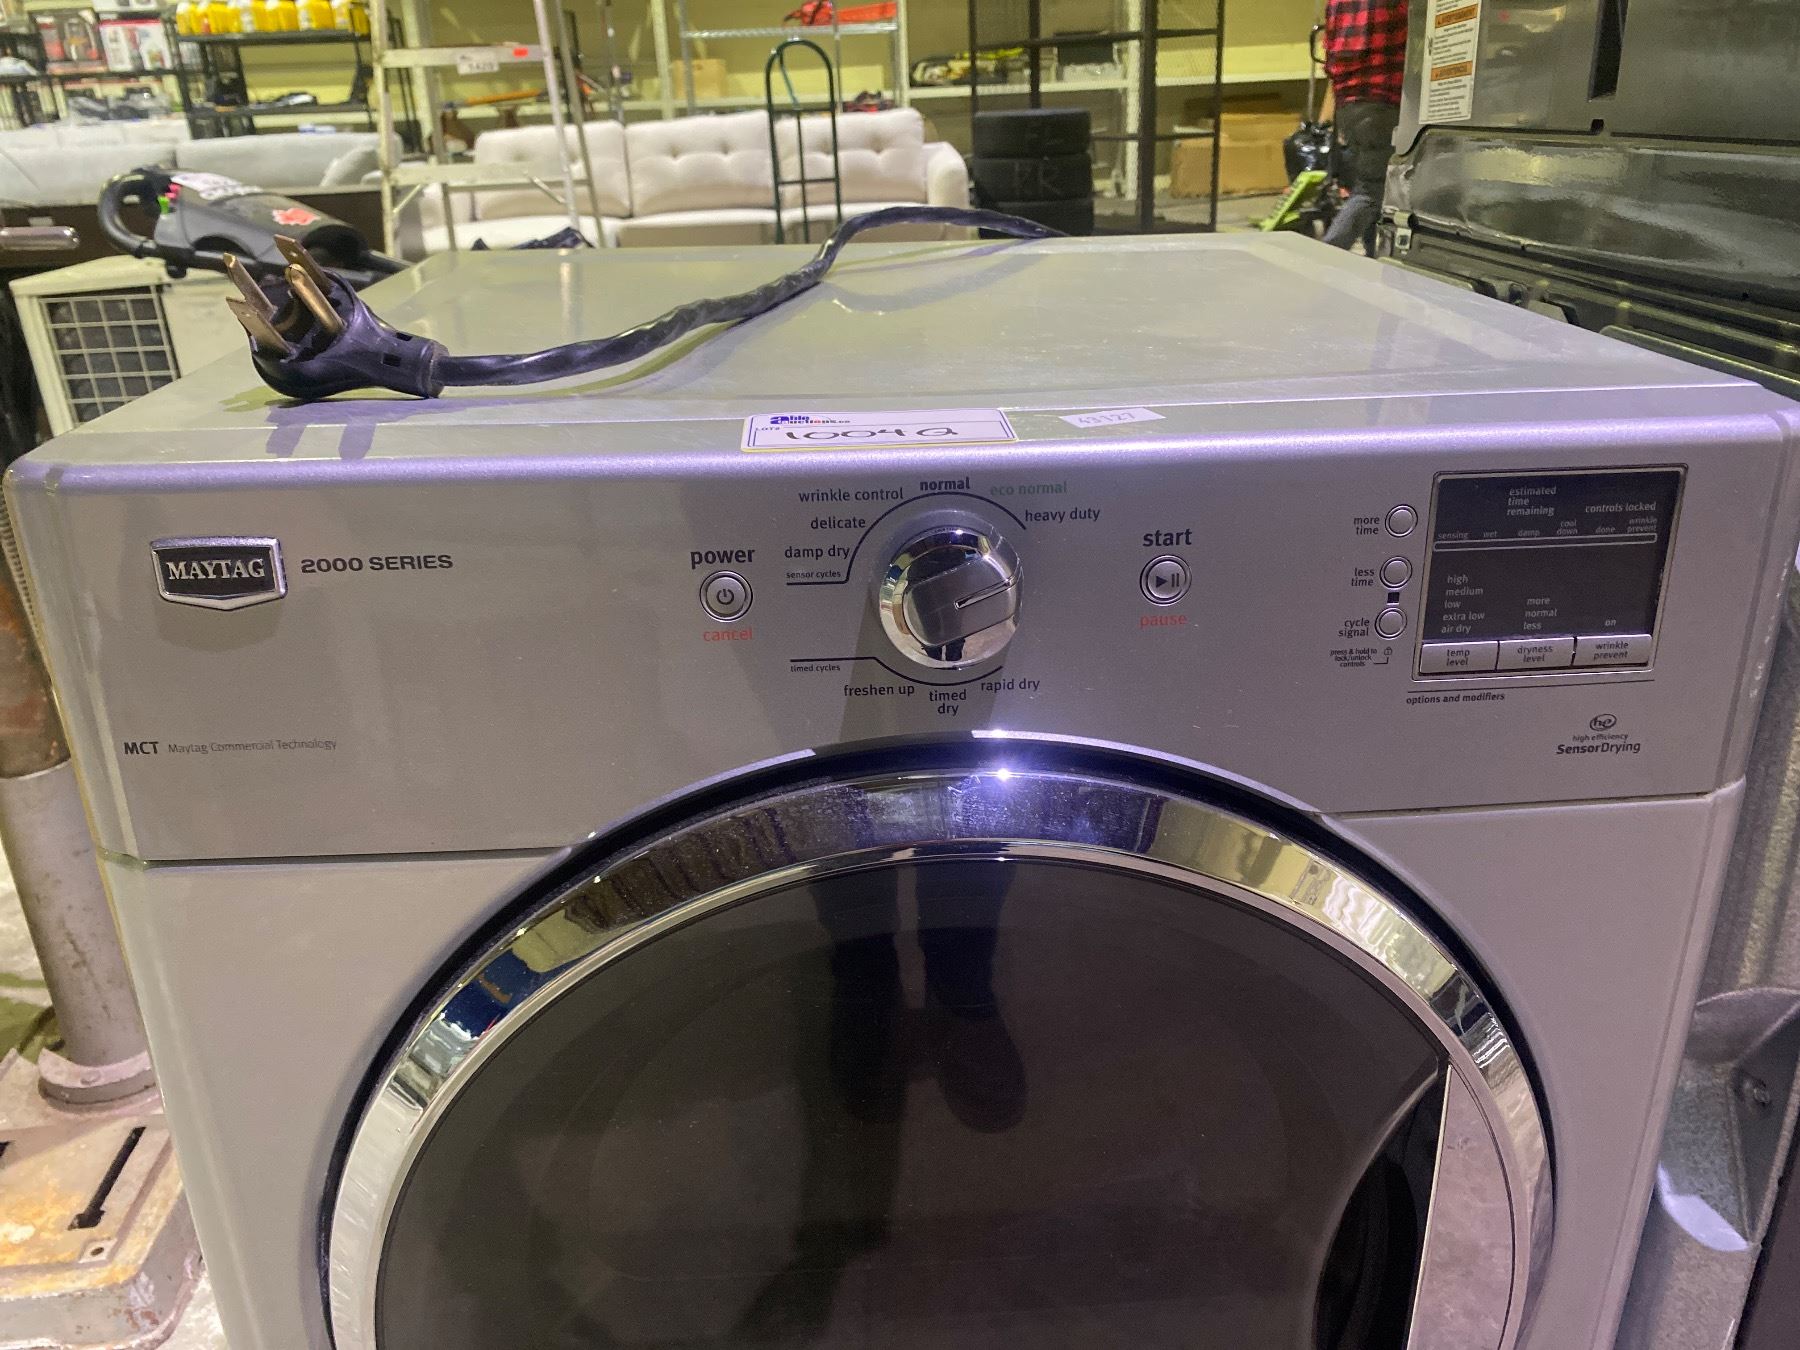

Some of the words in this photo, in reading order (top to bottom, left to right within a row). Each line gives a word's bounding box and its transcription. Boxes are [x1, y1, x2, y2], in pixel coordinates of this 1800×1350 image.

[920, 476, 970, 491] normal
[990, 486, 1014, 496] eco
[1018, 481, 1067, 495] normal
[798, 488, 850, 502] wrinkle
[854, 487, 904, 501] control
[1509, 486, 1557, 496] estimated
[1508, 497, 1530, 506] time
[1507, 506, 1555, 517] remaining
[1585, 503, 1623, 513] controls
[1625, 502, 1657, 512] locked
[1025, 509, 1066, 524] heavy
[1070, 507, 1101, 522] duty
[1629, 516, 1658, 525] wrinkle
[810, 516, 866, 530] delicate
[1354, 517, 1380, 526] more
[1560, 519, 1577, 528] cool
[1356, 526, 1379, 536] time
[1438, 530, 1469, 540] sensing
[1483, 530, 1498, 538] wet
[1518, 529, 1540, 538] damp
[1556, 527, 1578, 536] down
[1595, 526, 1616, 534] done
[1627, 525, 1657, 534] prevent
[1143, 528, 1193, 547] start
[784, 546, 824, 560] damp
[828, 544, 850, 560] dry
[301, 558, 364, 574] 2000
[368, 554, 454, 571] SERIES
[690, 549, 756, 570] power
[166, 558, 266, 580] MAYTAG
[1354, 568, 1375, 577] less
[786, 570, 814, 579] sensor
[815, 570, 841, 580] cycles
[1448, 574, 1468, 584] high
[1351, 577, 1374, 587] time
[1446, 588, 1484, 596] medium
[1444, 600, 1462, 609] low
[1527, 598, 1550, 606] more
[1442, 612, 1467, 622] extra
[1468, 612, 1486, 620] low
[1525, 608, 1558, 618] normal
[1140, 614, 1188, 631] pause
[1344, 618, 1370, 629] cycle
[1524, 621, 1542, 630] less
[1604, 618, 1616, 627] on
[1338, 628, 1370, 638] signal
[1441, 625, 1454, 634] air
[1456, 624, 1472, 634] dry
[703, 627, 753, 642] cancel
[1517, 645, 1554, 655] dryness
[1595, 641, 1629, 650] wrinkle
[1446, 649, 1470, 659] temp
[1523, 654, 1545, 663] level
[1594, 650, 1628, 660] prevent
[1446, 658, 1469, 667] level
[790, 664, 814, 672] timed
[816, 664, 841, 673] cycles
[981, 679, 1015, 693] rapid
[1019, 678, 1041, 692] dry
[844, 684, 894, 697] freshen
[898, 685, 916, 698] up
[929, 689, 968, 702] timed
[1406, 694, 1441, 706] options
[1443, 694, 1460, 703] and
[1462, 692, 1505, 702] modifiers
[938, 702, 960, 717] dry
[1572, 733, 1590, 743] high
[1591, 732, 1629, 742] efficiency
[124, 742, 159, 755] MCT
[168, 743, 209, 755] Maytag
[210, 740, 273, 752] Commercial
[276, 738, 337, 751] Technology
[1556, 742, 1641, 755] SensorDrying
